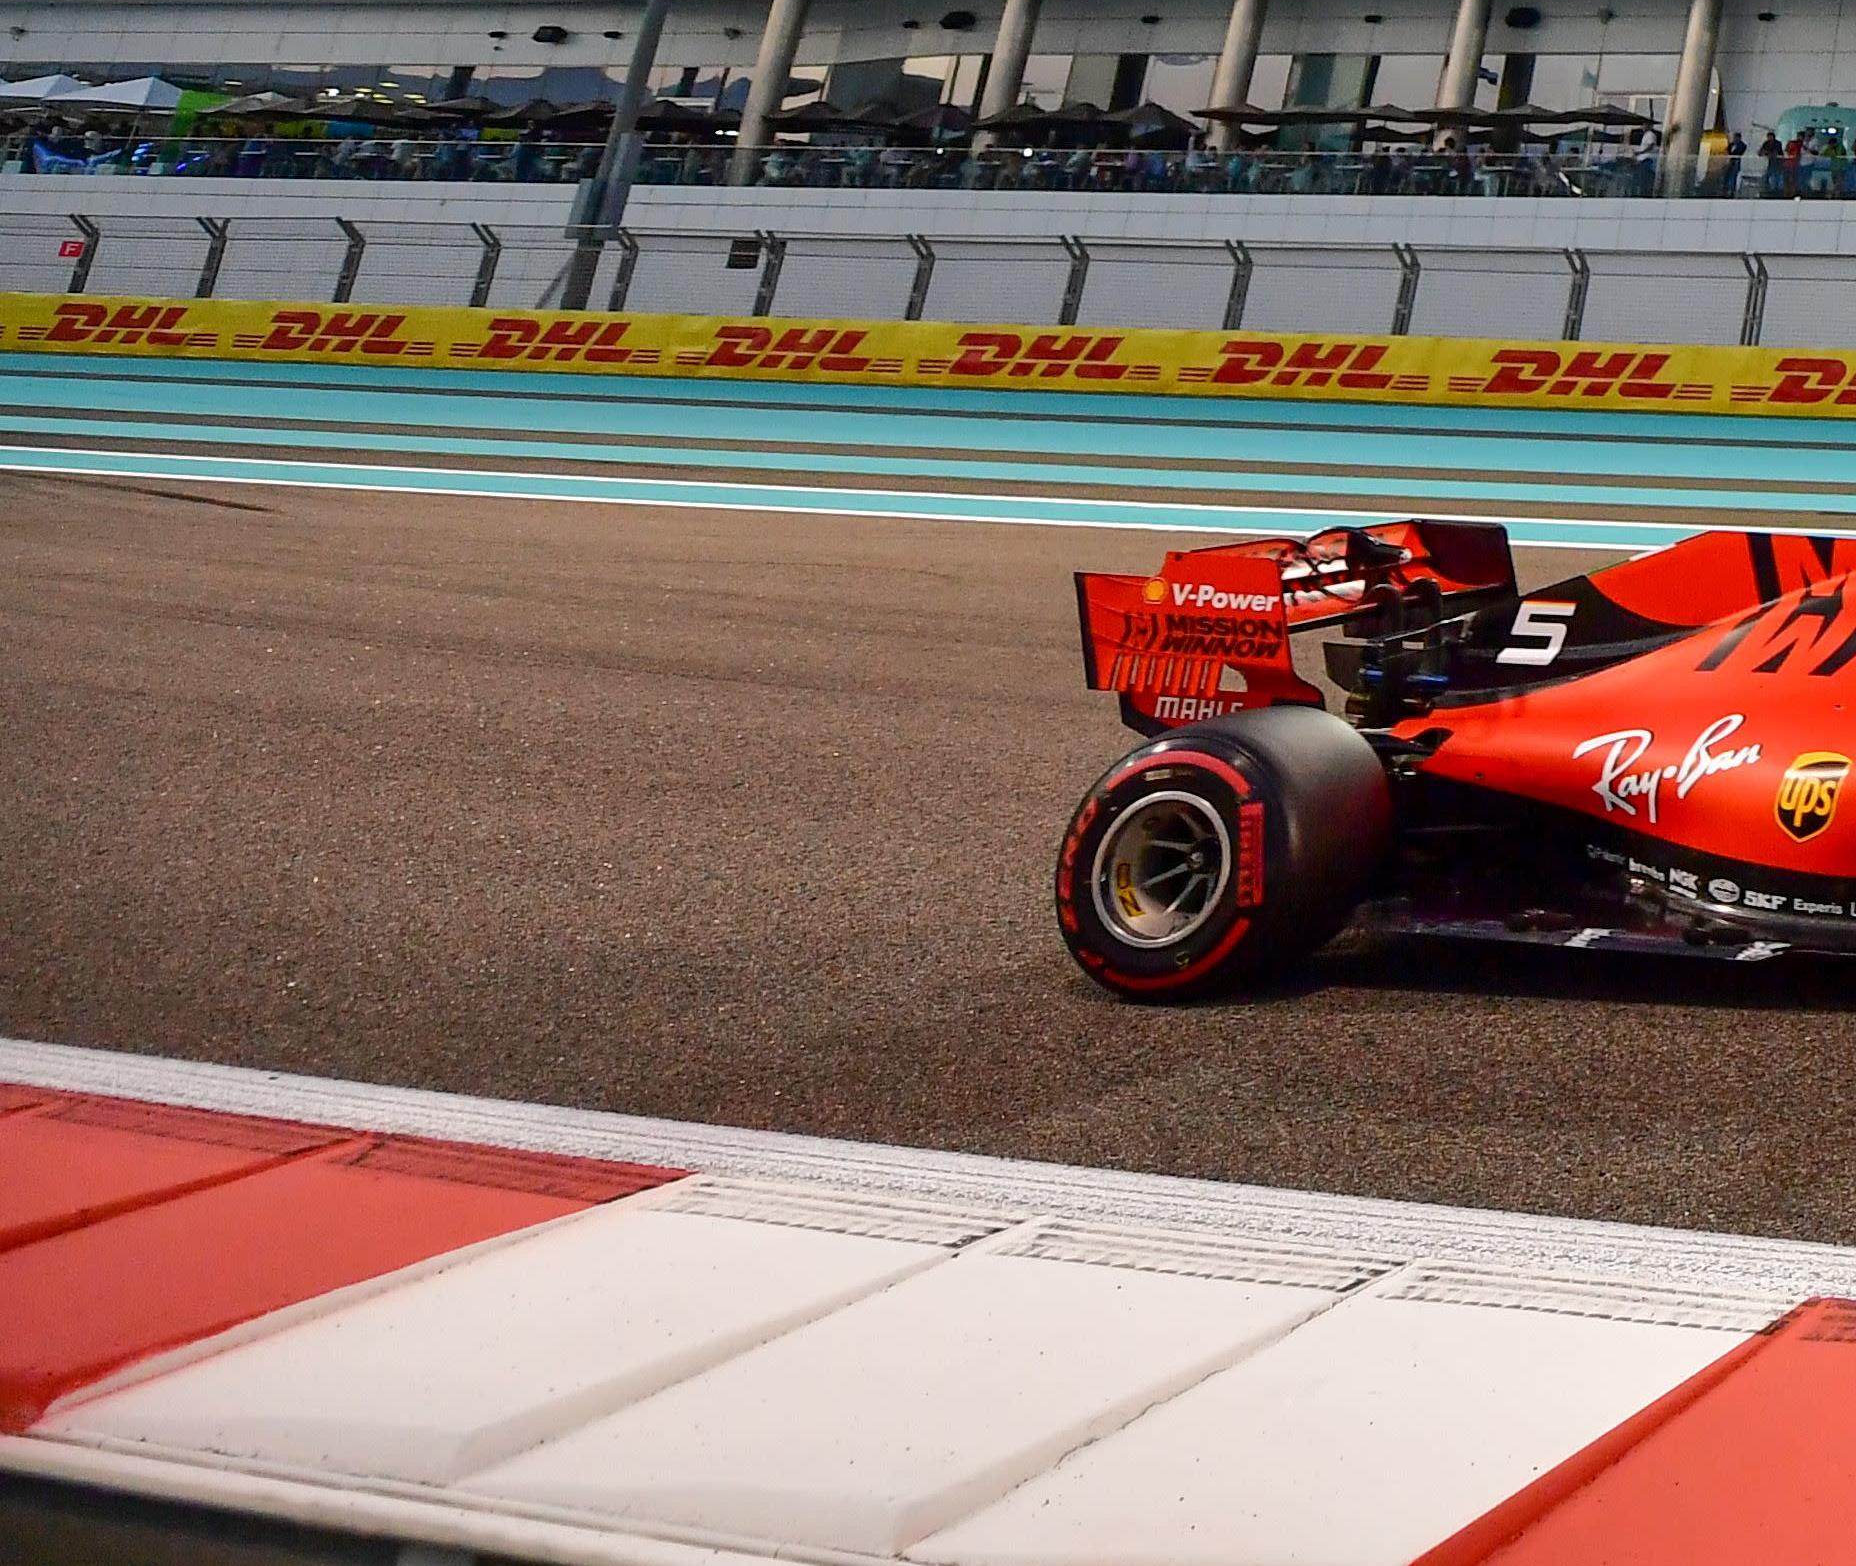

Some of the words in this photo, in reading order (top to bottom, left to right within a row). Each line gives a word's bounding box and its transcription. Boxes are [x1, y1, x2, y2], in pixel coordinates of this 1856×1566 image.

[46, 304, 190, 347] DHL
[262, 311, 407, 355] DHL
[478, 319, 632, 362] DHL
[705, 326, 870, 372] DHL
[949, 333, 1128, 380] DHL
[1212, 341, 1393, 389] DHL
[1482, 350, 1674, 398] DHL
[1172, 582, 1280, 613] V-Power
[1161, 635, 1281, 658] WINNOW
[1165, 613, 1283, 637] MISSION
[1496, 599, 1578, 666] 5
[1743, 890, 1788, 910] SKF
[1793, 897, 1844, 915] Experis
